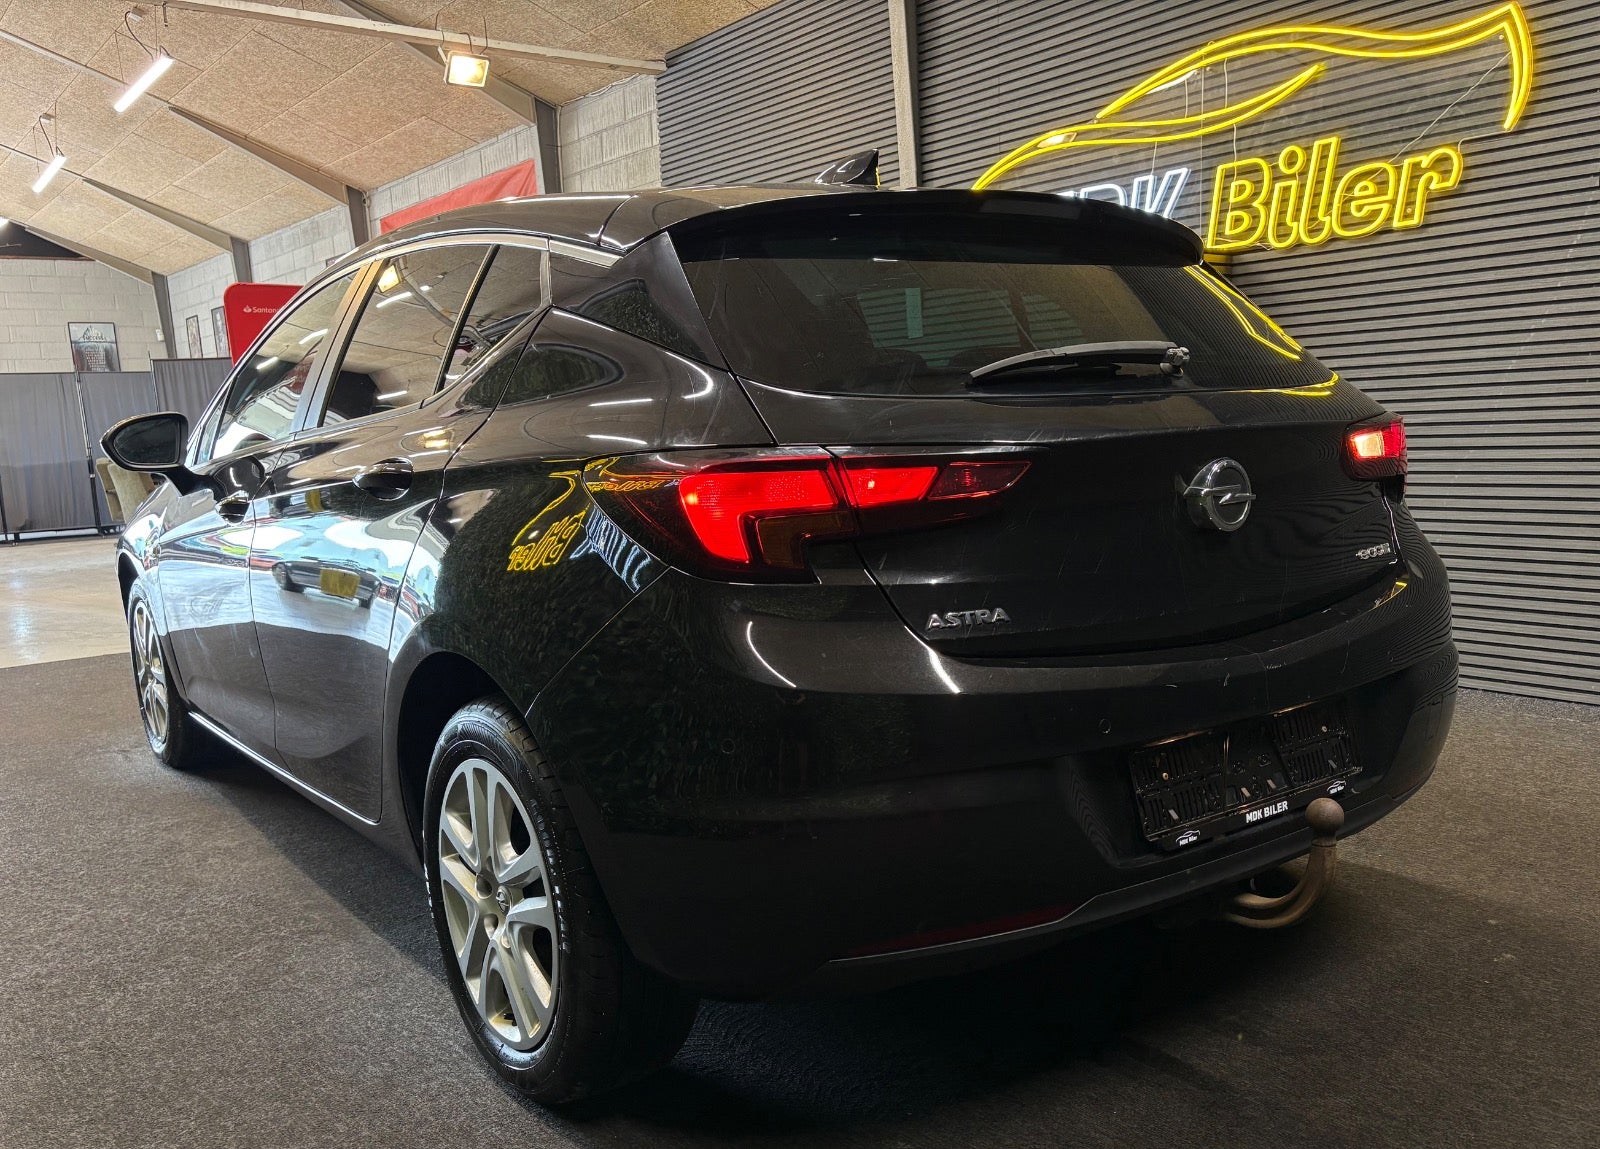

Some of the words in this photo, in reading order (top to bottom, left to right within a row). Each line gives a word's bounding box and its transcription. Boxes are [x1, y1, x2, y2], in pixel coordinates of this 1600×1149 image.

[1206, 136, 1464, 250] Biler
[925, 607, 1011, 631] ASTRA
[1246, 808, 1263, 823] MDK
[1263, 800, 1289, 818] BILER
